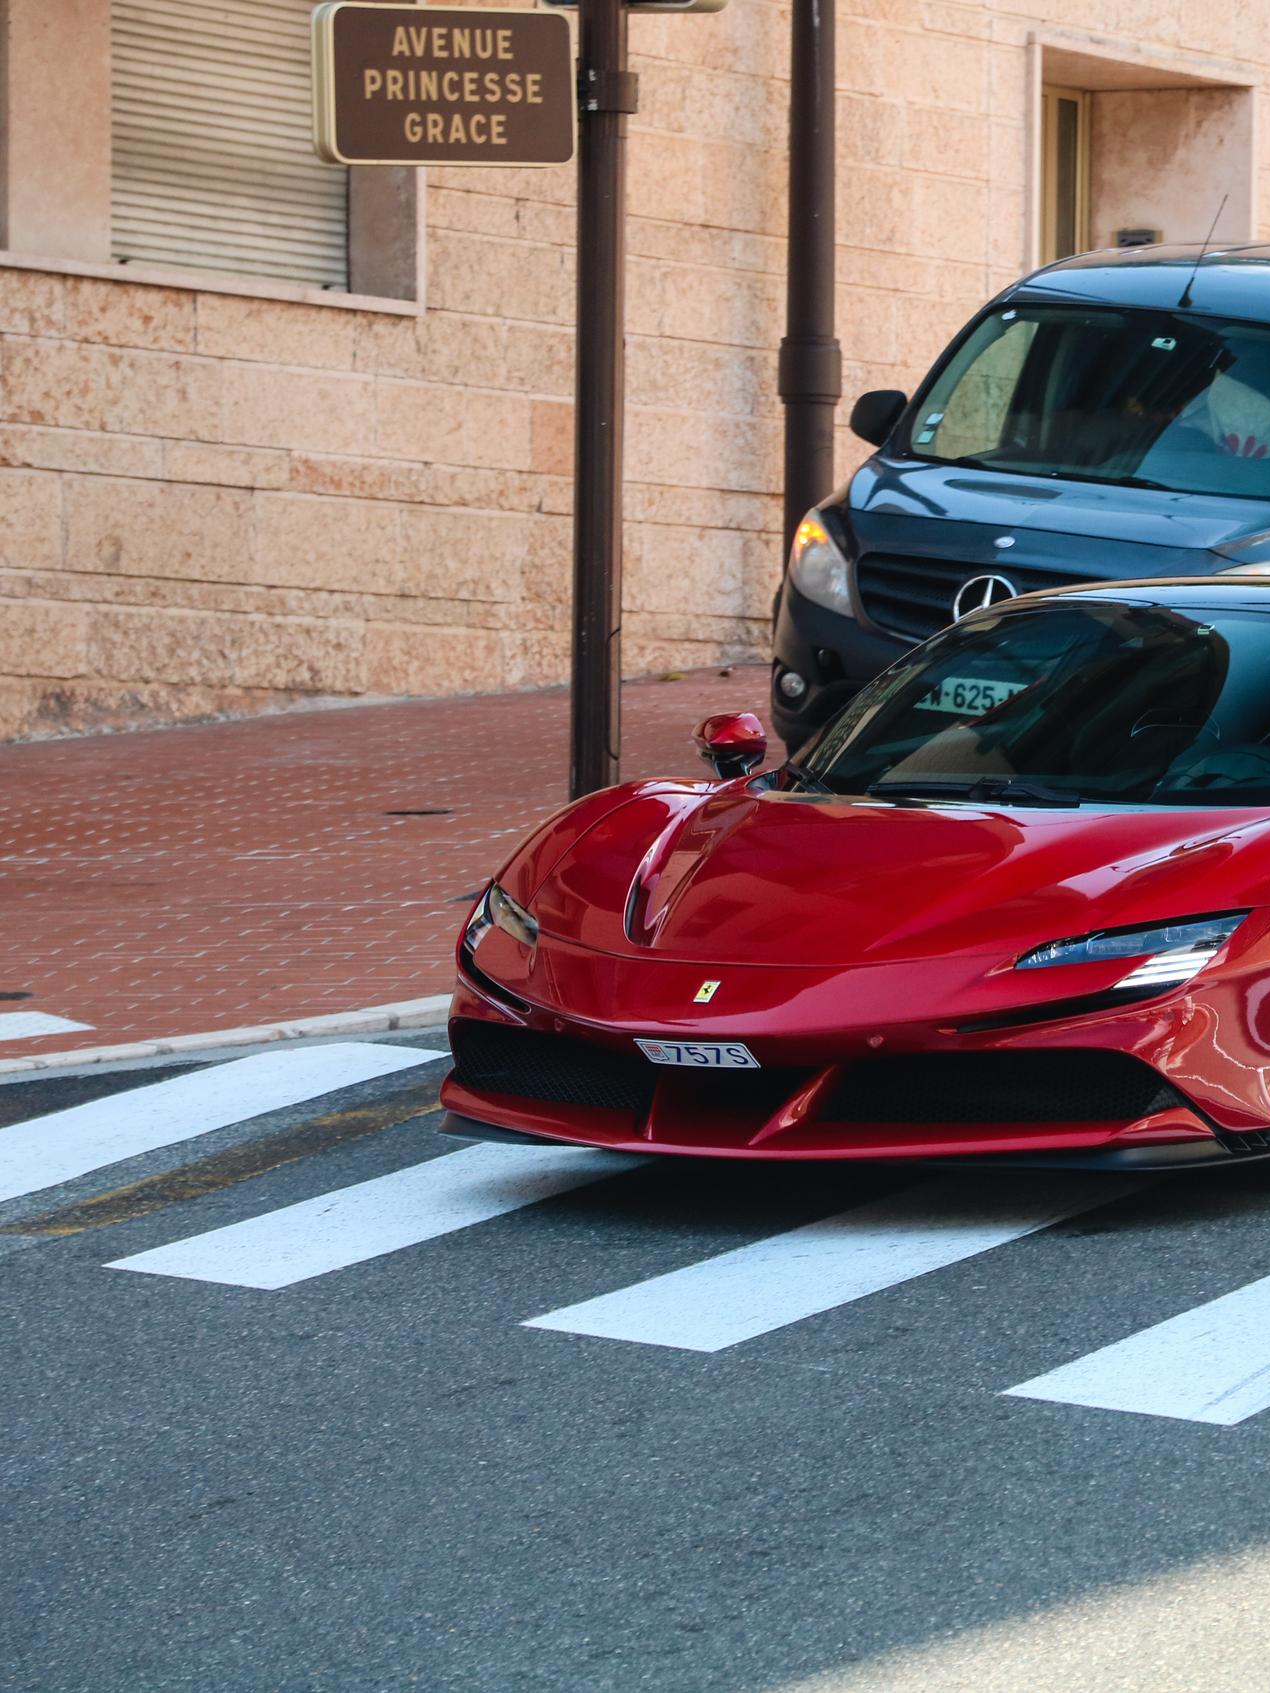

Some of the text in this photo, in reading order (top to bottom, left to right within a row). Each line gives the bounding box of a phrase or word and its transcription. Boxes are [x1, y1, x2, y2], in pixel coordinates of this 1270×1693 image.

[392, 26, 514, 60] AVENUE
[364, 69, 544, 104] PRINCESSE
[404, 112, 508, 144] GRACE
[664, 1045, 749, 1065] 757S
